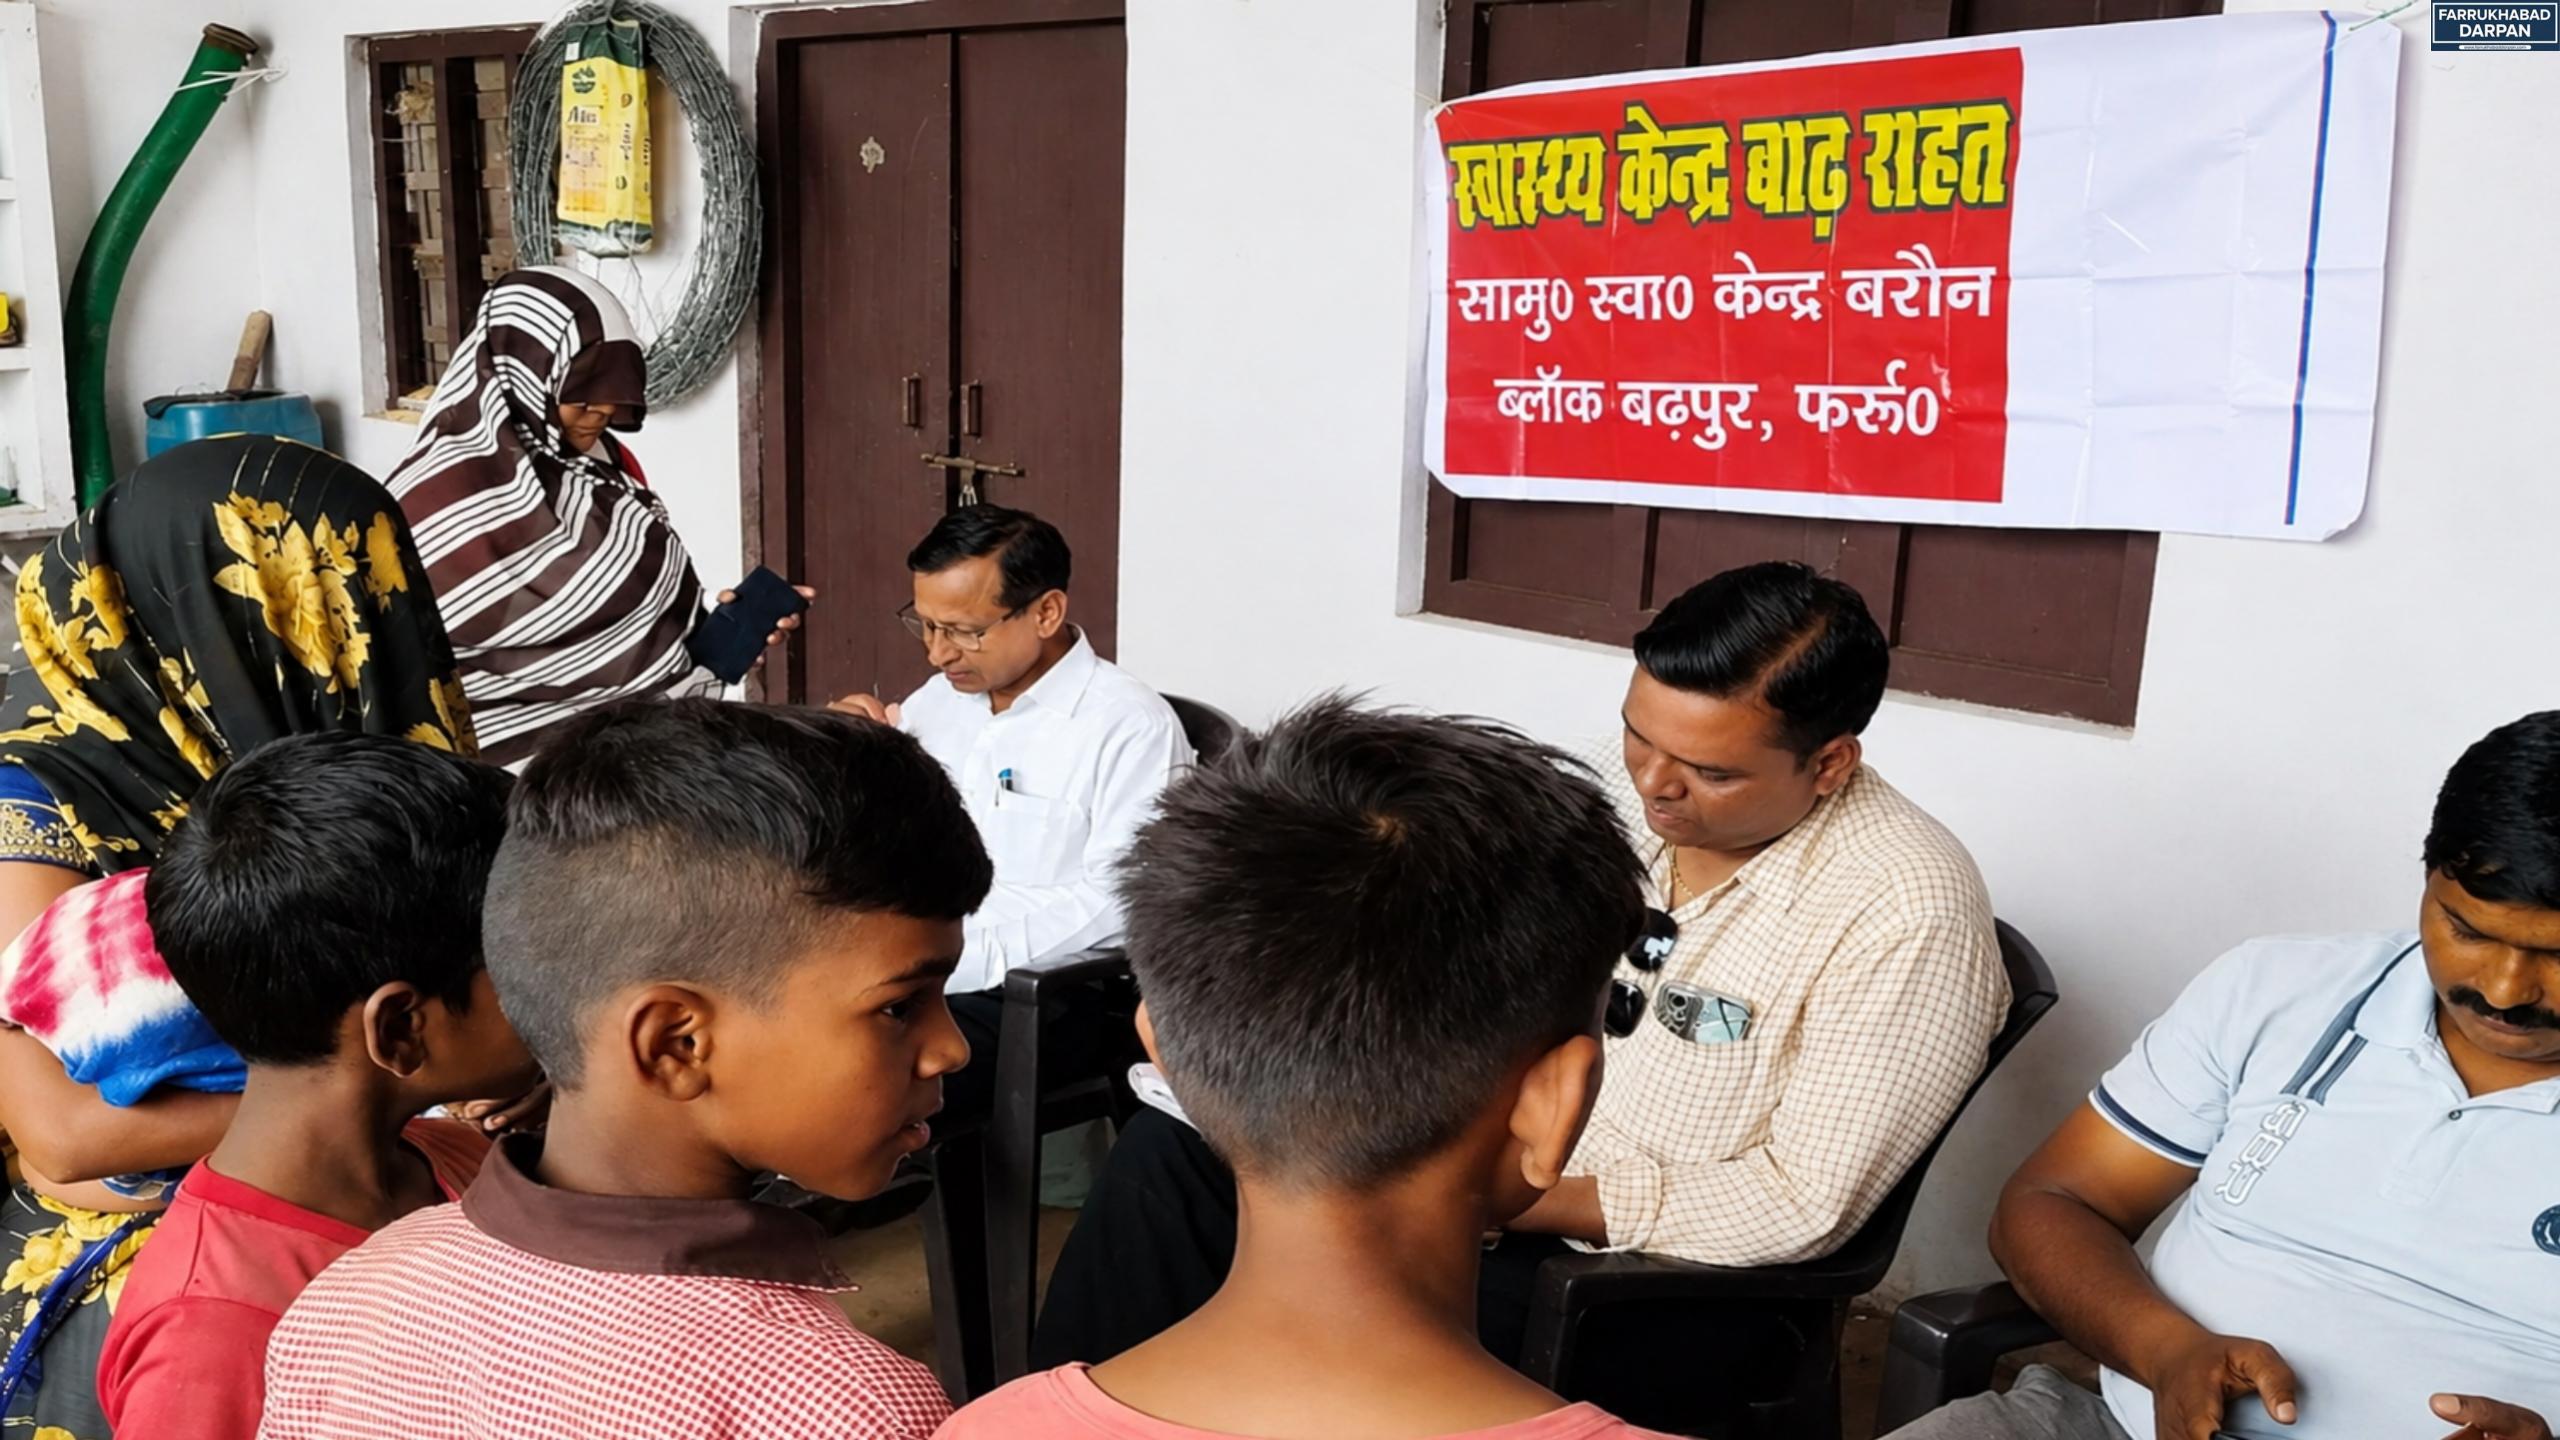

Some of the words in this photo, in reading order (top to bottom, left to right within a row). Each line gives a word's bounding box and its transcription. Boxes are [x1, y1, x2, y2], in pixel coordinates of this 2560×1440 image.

[1447, 132, 1607, 230] स्वास्थ्य
[1616, 101, 1731, 228] केन्द्र
[1740, 110, 1852, 243] बाढ़
[1862, 99, 2014, 210] राहत
[1713, 251, 1825, 322] केन्द्र
[1841, 243, 1997, 317] बरौन
[1493, 365, 1605, 424] ब्लॉक
[1617, 379, 1775, 451] बढ़पुर,
